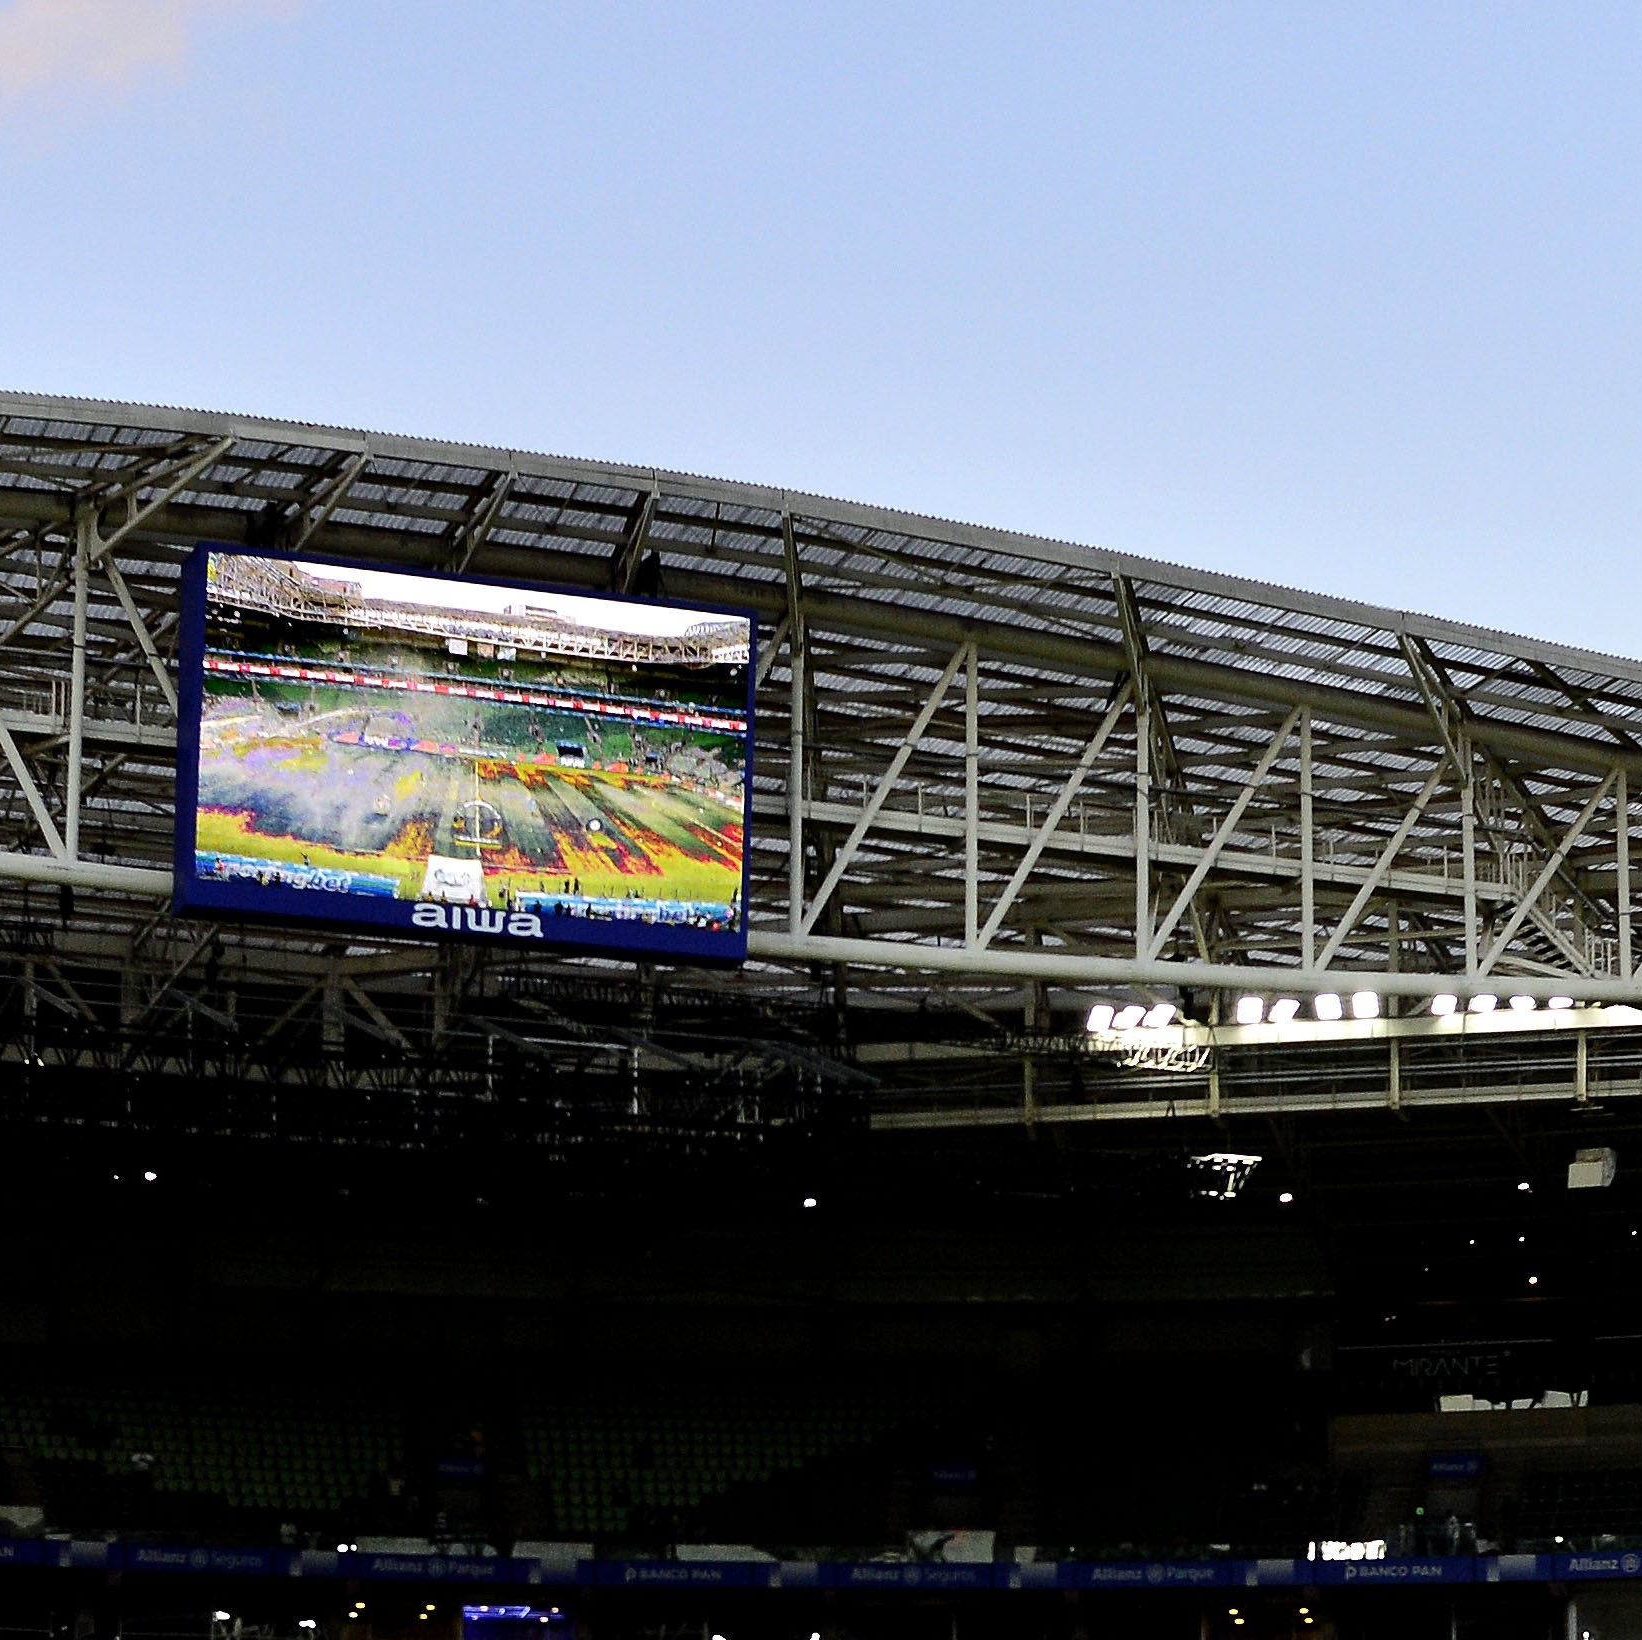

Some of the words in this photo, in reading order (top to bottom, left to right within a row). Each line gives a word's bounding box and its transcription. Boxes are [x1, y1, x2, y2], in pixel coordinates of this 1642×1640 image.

[413, 902, 544, 938] aiwa
[1393, 1353, 1501, 1378] MIRANTE
[136, 1546, 189, 1566] Allianz
[211, 1550, 264, 1570] Seguros
[372, 1557, 425, 1575] Allianz
[447, 1558, 496, 1580] Parque
[1568, 1553, 1620, 1573] Allianz
[638, 1567, 686, 1580] BANCO
[688, 1567, 723, 1581] PAN
[850, 1566, 902, 1583] Allianz
[924, 1566, 976, 1587] Seguros
[1092, 1566, 1144, 1583] Allianz
[1166, 1565, 1215, 1587] Parque
[1358, 1563, 1407, 1579] BANCO
[1408, 1563, 1444, 1579] PAN
